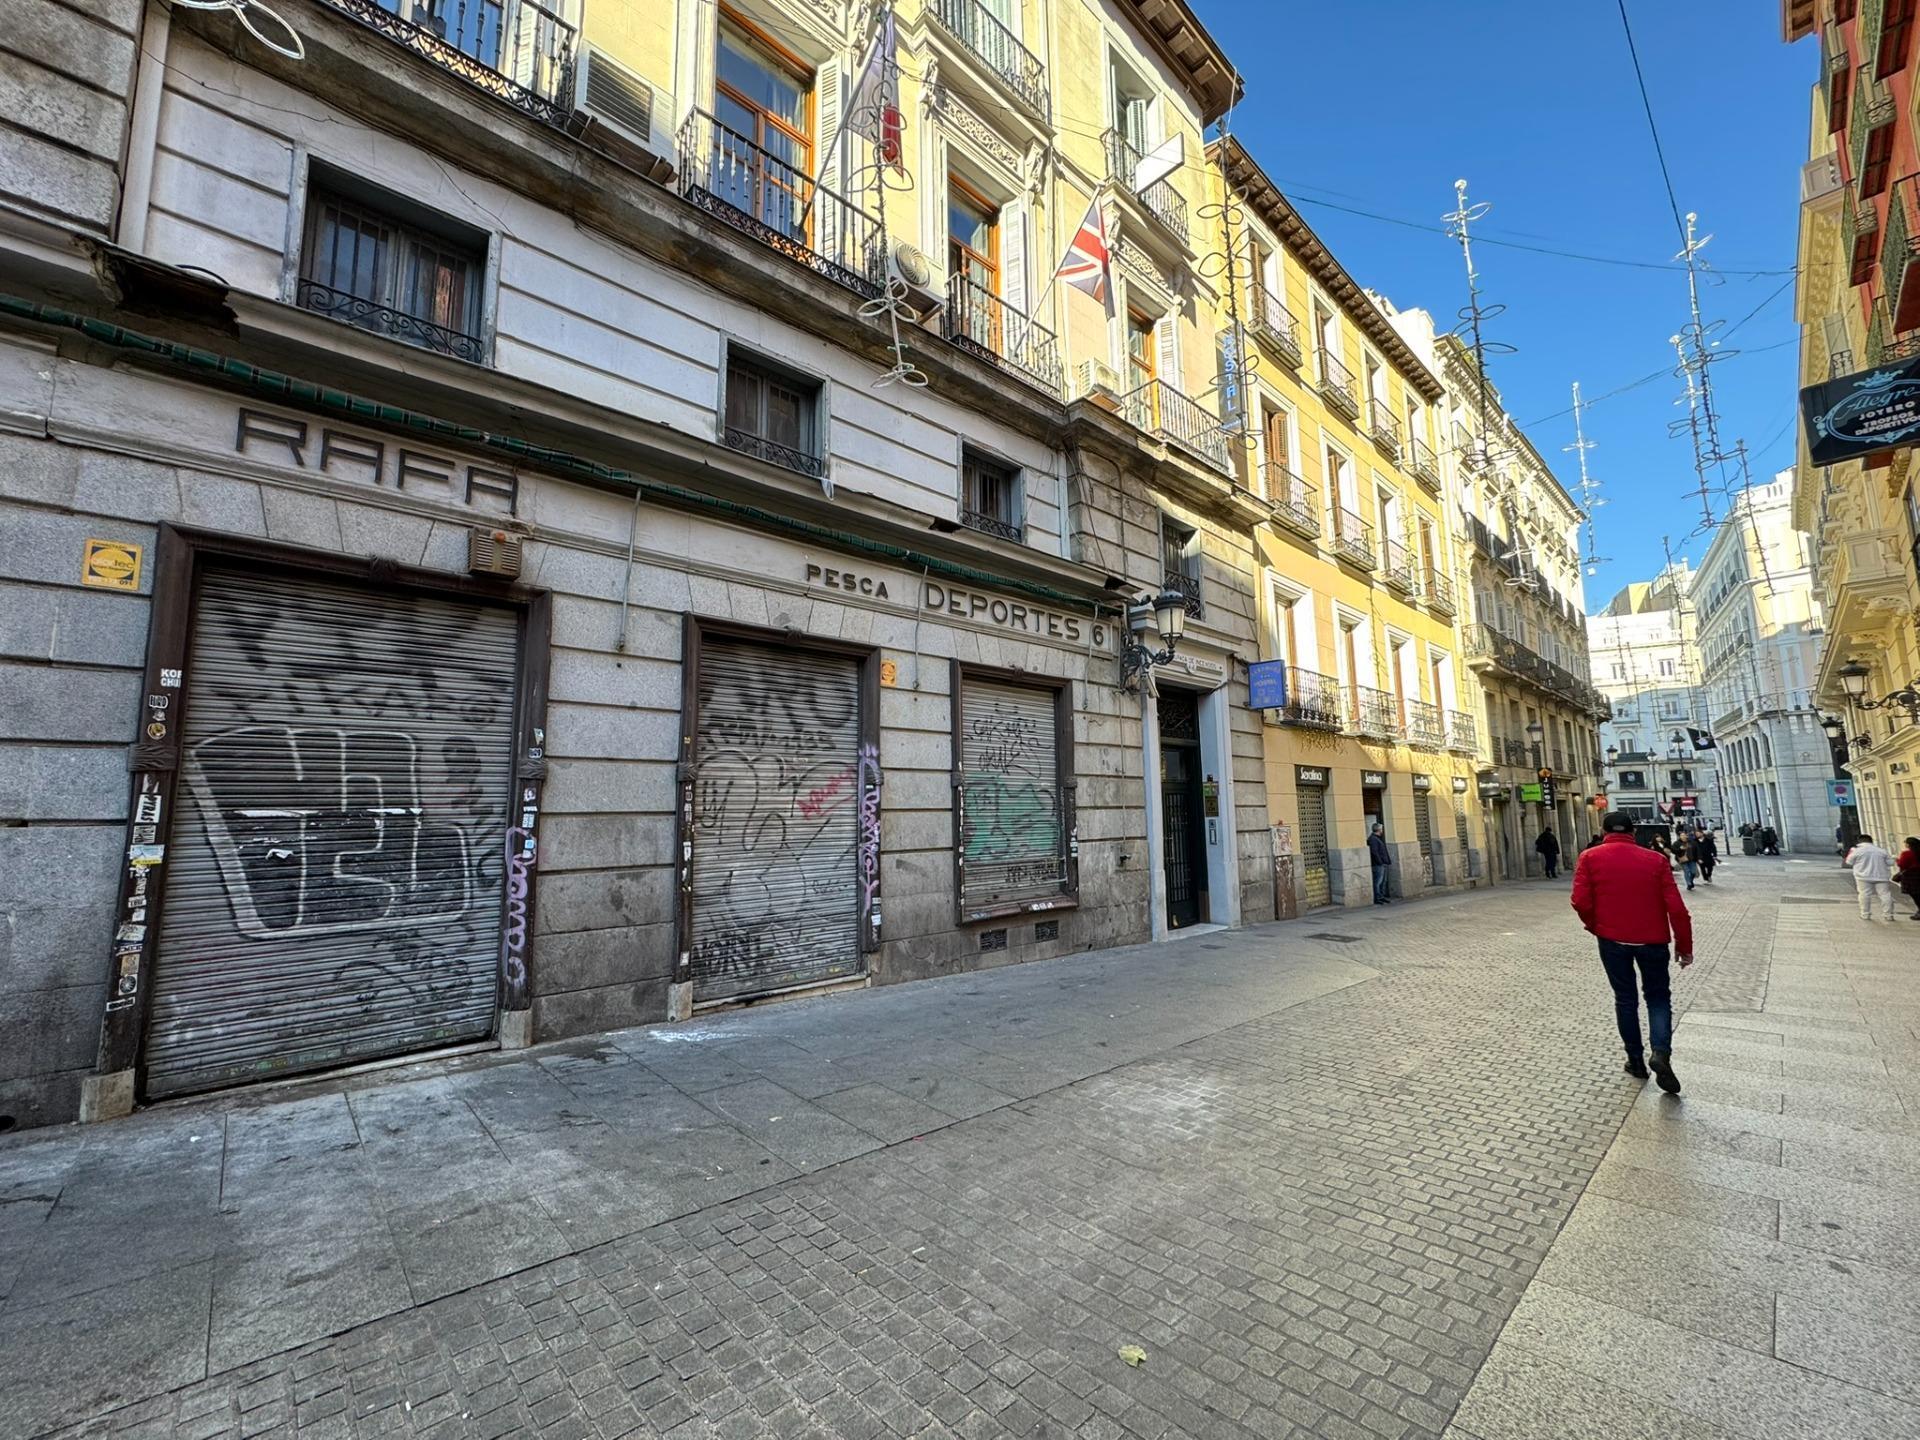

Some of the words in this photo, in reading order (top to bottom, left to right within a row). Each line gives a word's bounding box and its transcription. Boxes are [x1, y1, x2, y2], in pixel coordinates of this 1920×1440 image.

[1835, 386, 1919, 420] Alegre
[1858, 400, 1916, 421] JOYERO
[1863, 410, 1915, 428] TROFEOS
[236, 407, 520, 515] RAFA
[806, 562, 889, 599] PESCA
[925, 582, 1080, 641] DEPORTES
[1092, 624, 1104, 646] 6
